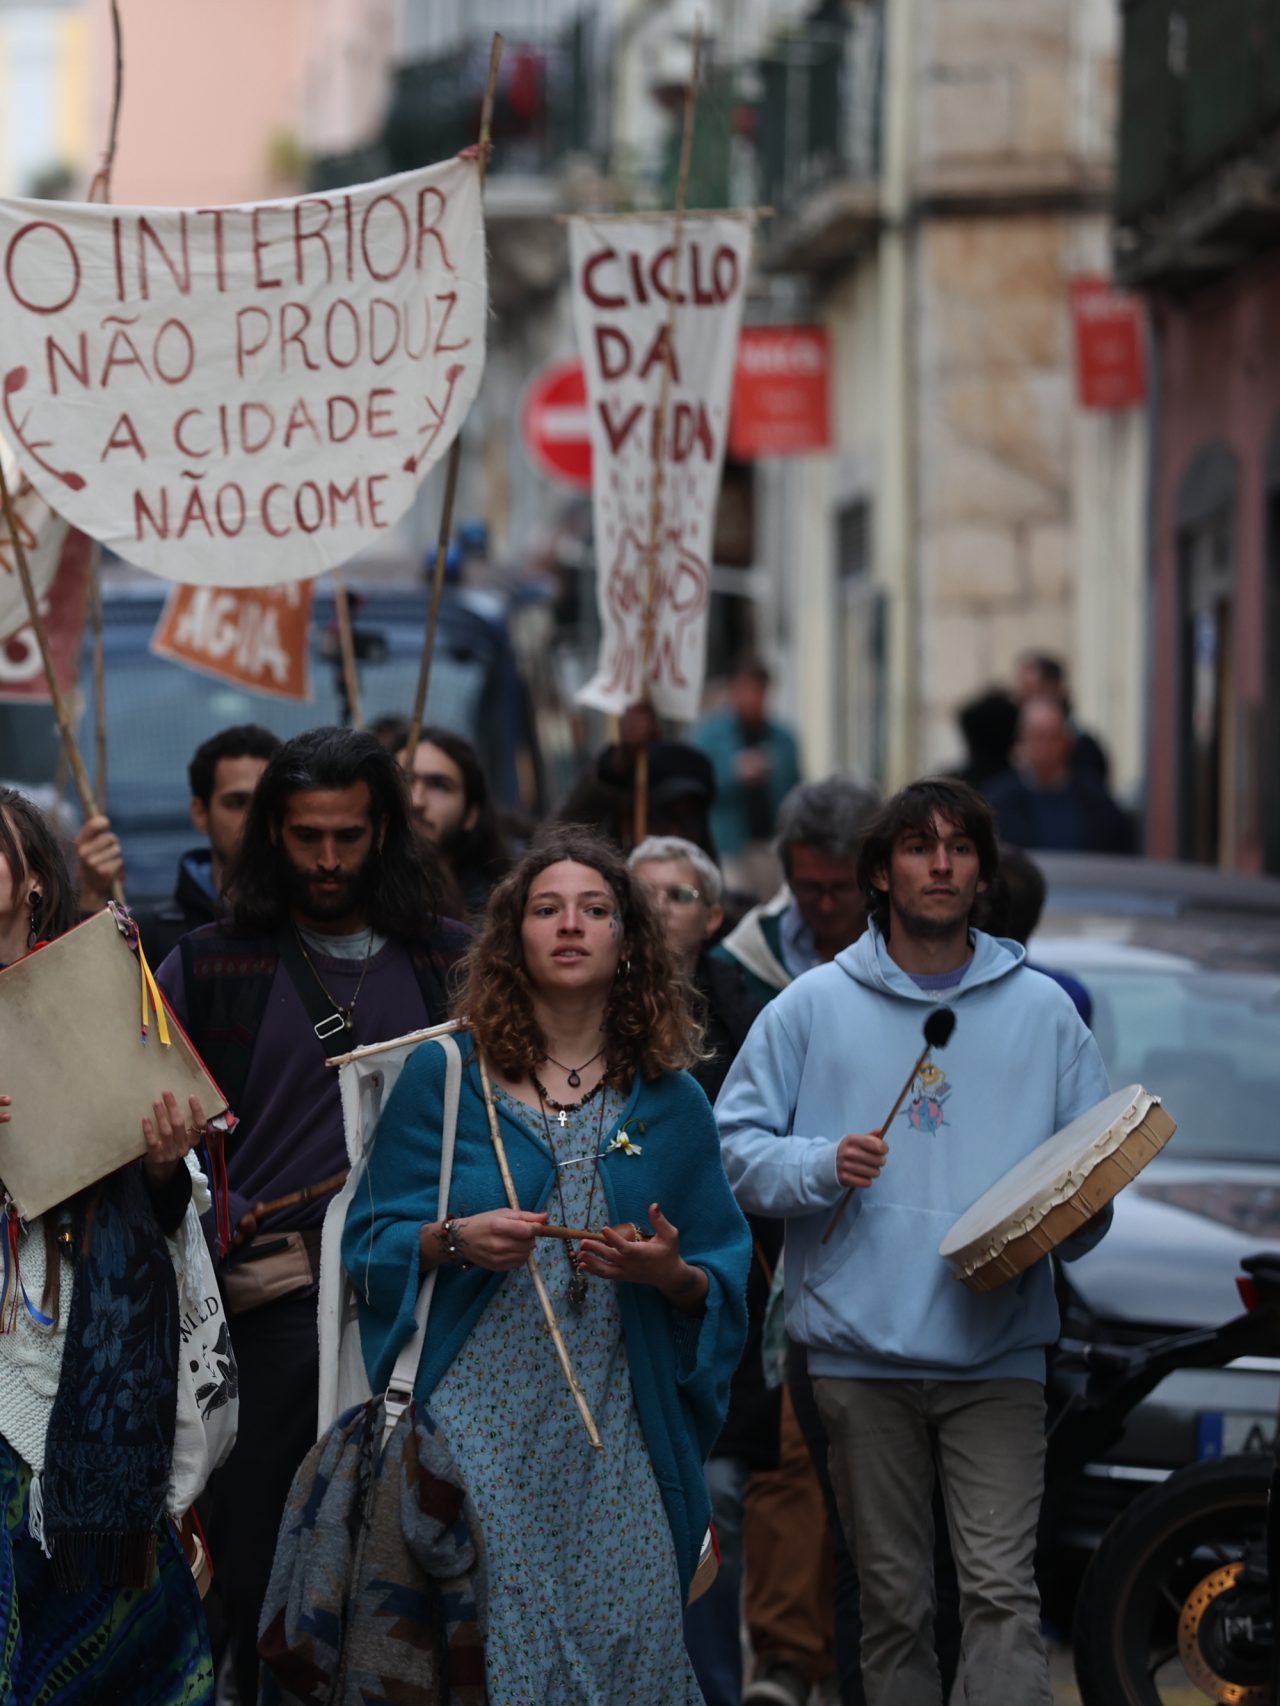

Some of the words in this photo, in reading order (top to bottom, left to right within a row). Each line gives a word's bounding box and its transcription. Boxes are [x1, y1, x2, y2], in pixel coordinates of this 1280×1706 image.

[5, 221, 81, 315] O
[113, 186, 456, 303] INTERIOR
[582, 242, 740, 309] CICLO
[45, 314, 195, 396] NÃO
[236, 291, 470, 378] PRODUZ
[594, 324, 680, 385] DA
[101, 413, 147, 462] A
[173, 388, 398, 459] CIDADE
[598, 400, 715, 464] VIDA
[133, 470, 246, 542] NÃO
[260, 475, 390, 538] COME
